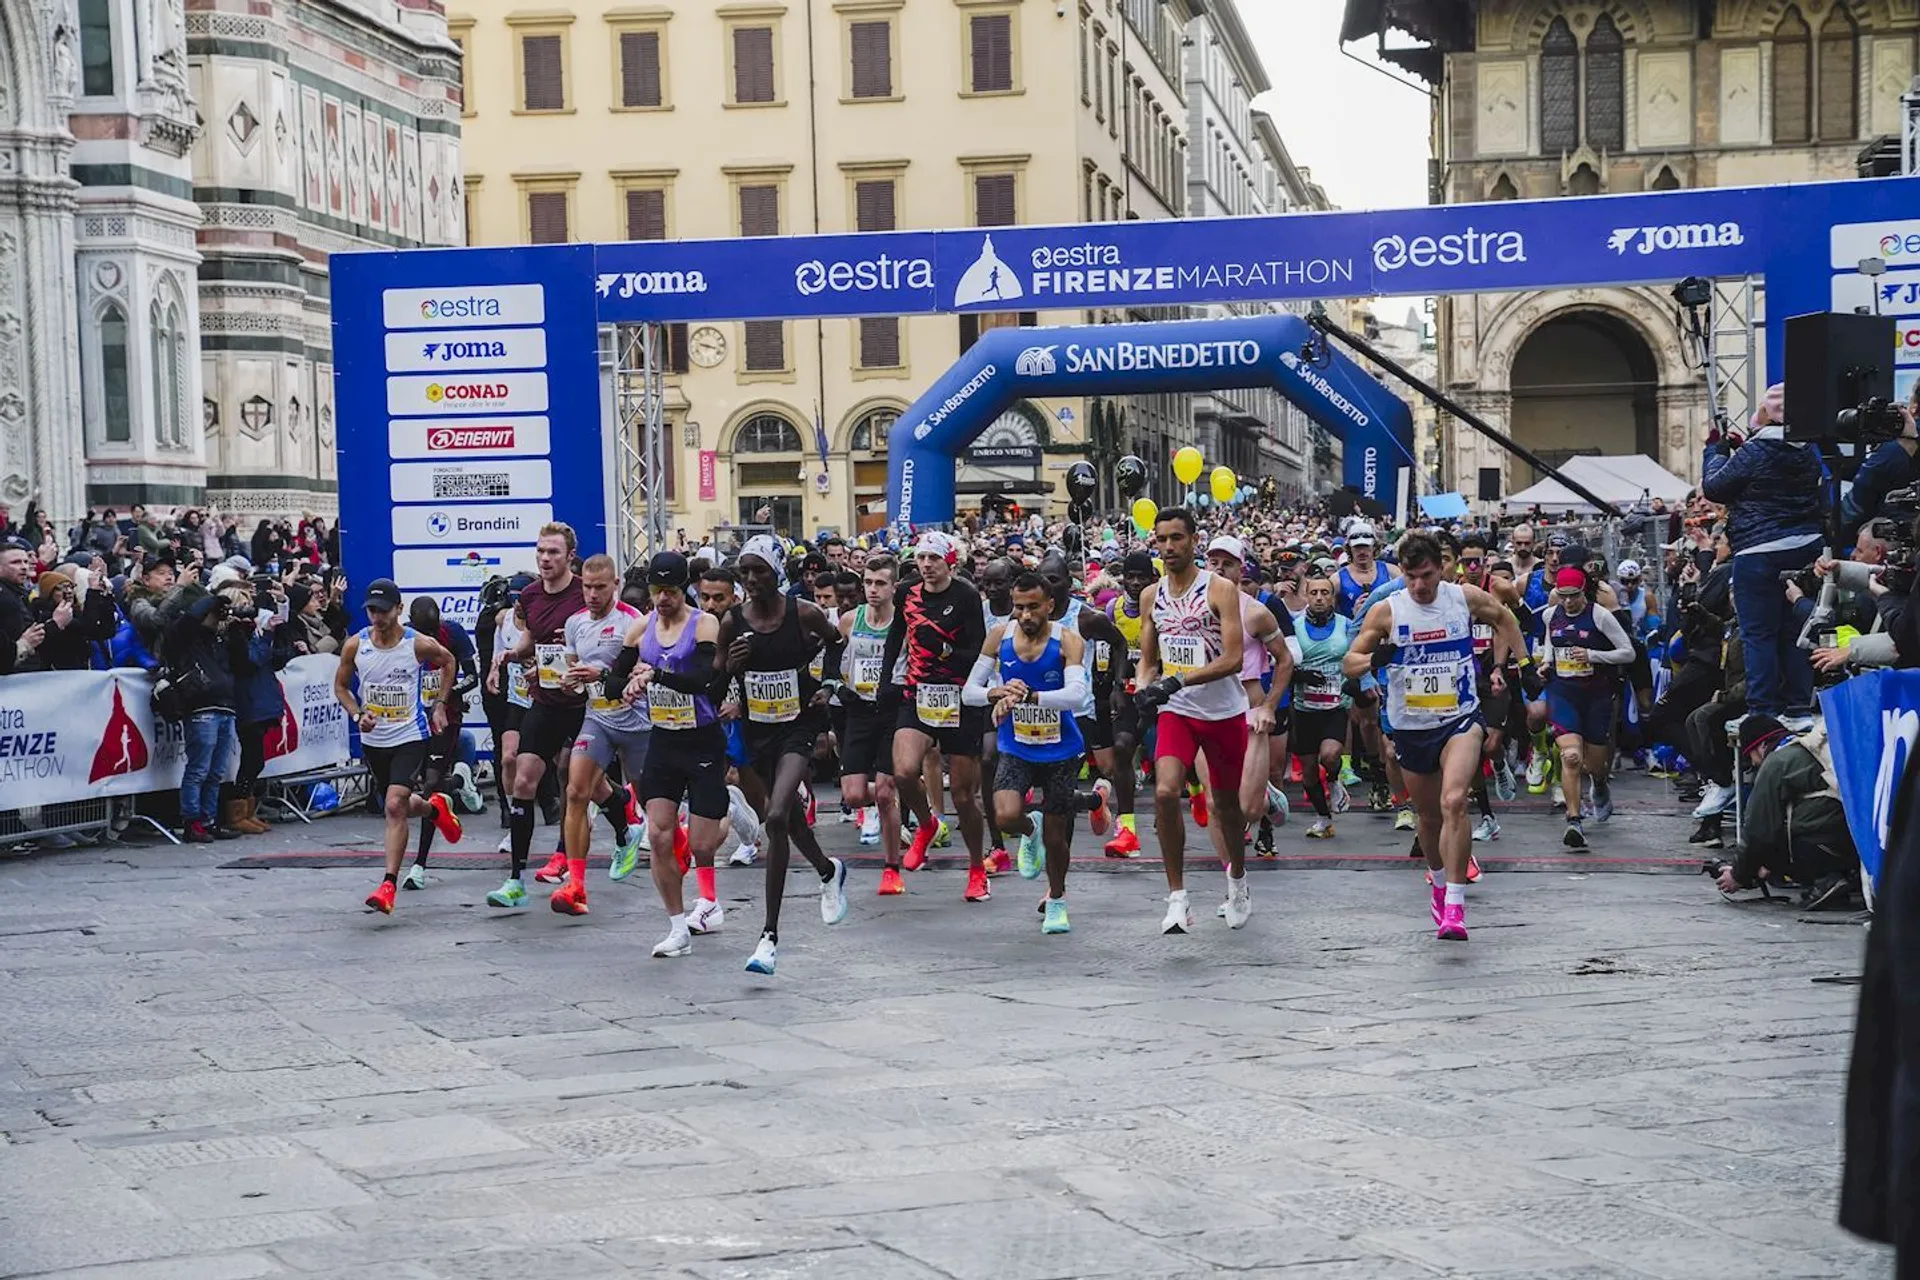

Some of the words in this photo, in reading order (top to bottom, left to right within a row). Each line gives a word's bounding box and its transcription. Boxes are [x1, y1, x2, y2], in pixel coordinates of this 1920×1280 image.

[1051, 242, 1121, 267] estra
[1410, 227, 1526, 267] estra
[828, 254, 934, 292] estra
[440, 296, 501, 317] estra
[444, 384, 509, 399] CONAD
[702, 455, 711, 487] MUSEO
[433, 474, 510, 486] DESTINATION
[434, 485, 489, 498] FLORENCE
[457, 516, 520, 530] Brandini
[751, 682, 792, 700] EKIDOR
[1423, 676, 1439, 693] 20
[927, 693, 949, 707] 3510
[302, 703, 342, 727] FIRENZE
[1012, 707, 1058, 723] BOUFARS
